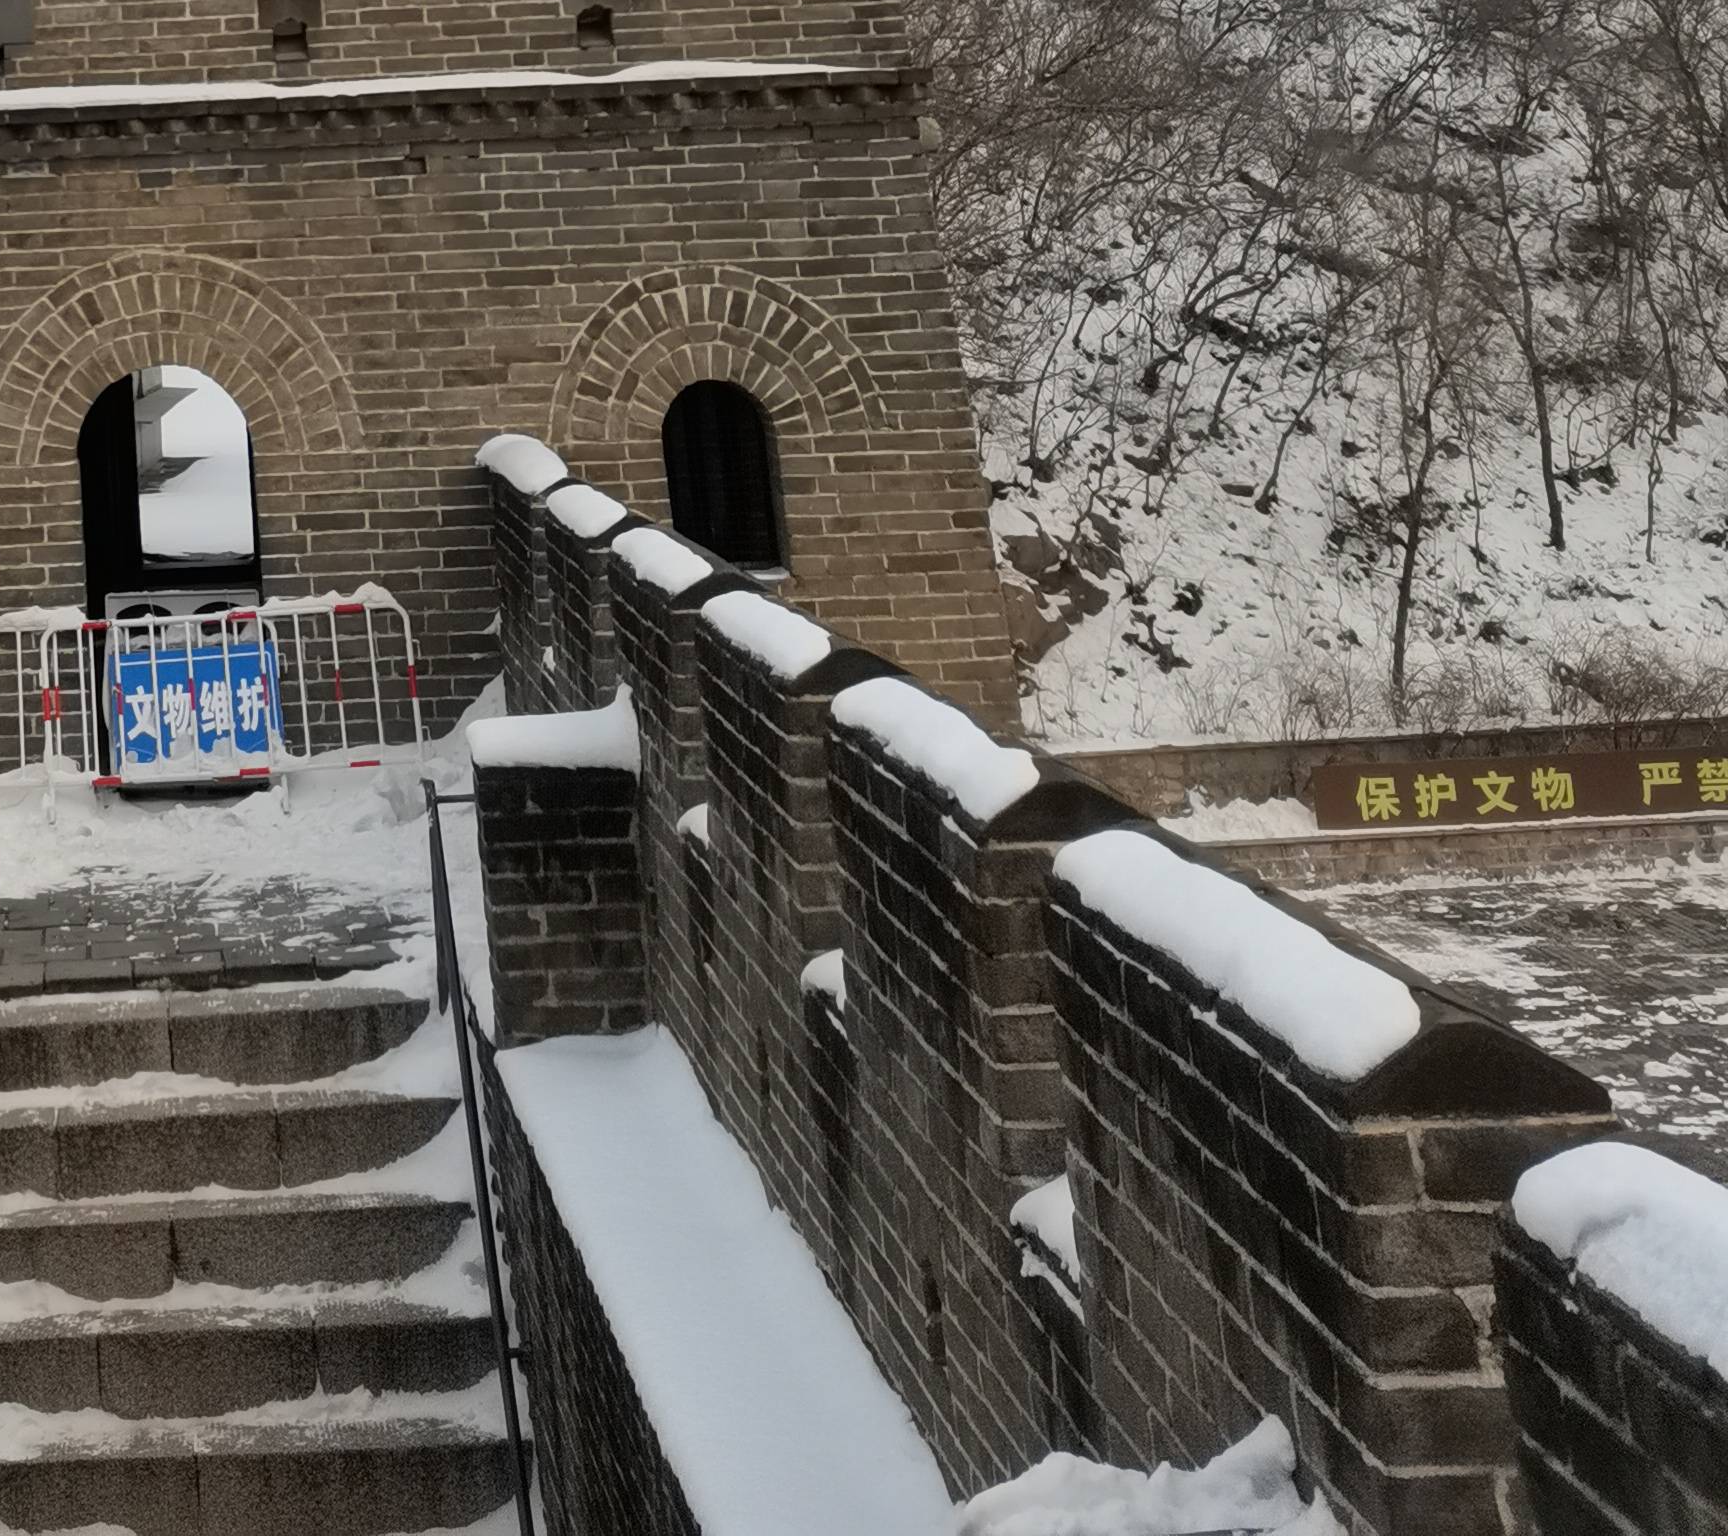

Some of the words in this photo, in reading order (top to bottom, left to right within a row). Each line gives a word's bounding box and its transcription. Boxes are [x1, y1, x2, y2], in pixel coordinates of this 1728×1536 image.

[125, 677, 266, 740] 文物维护
[1356, 767, 1575, 821] 保护文物
[1638, 758, 1728, 806] 严禁
